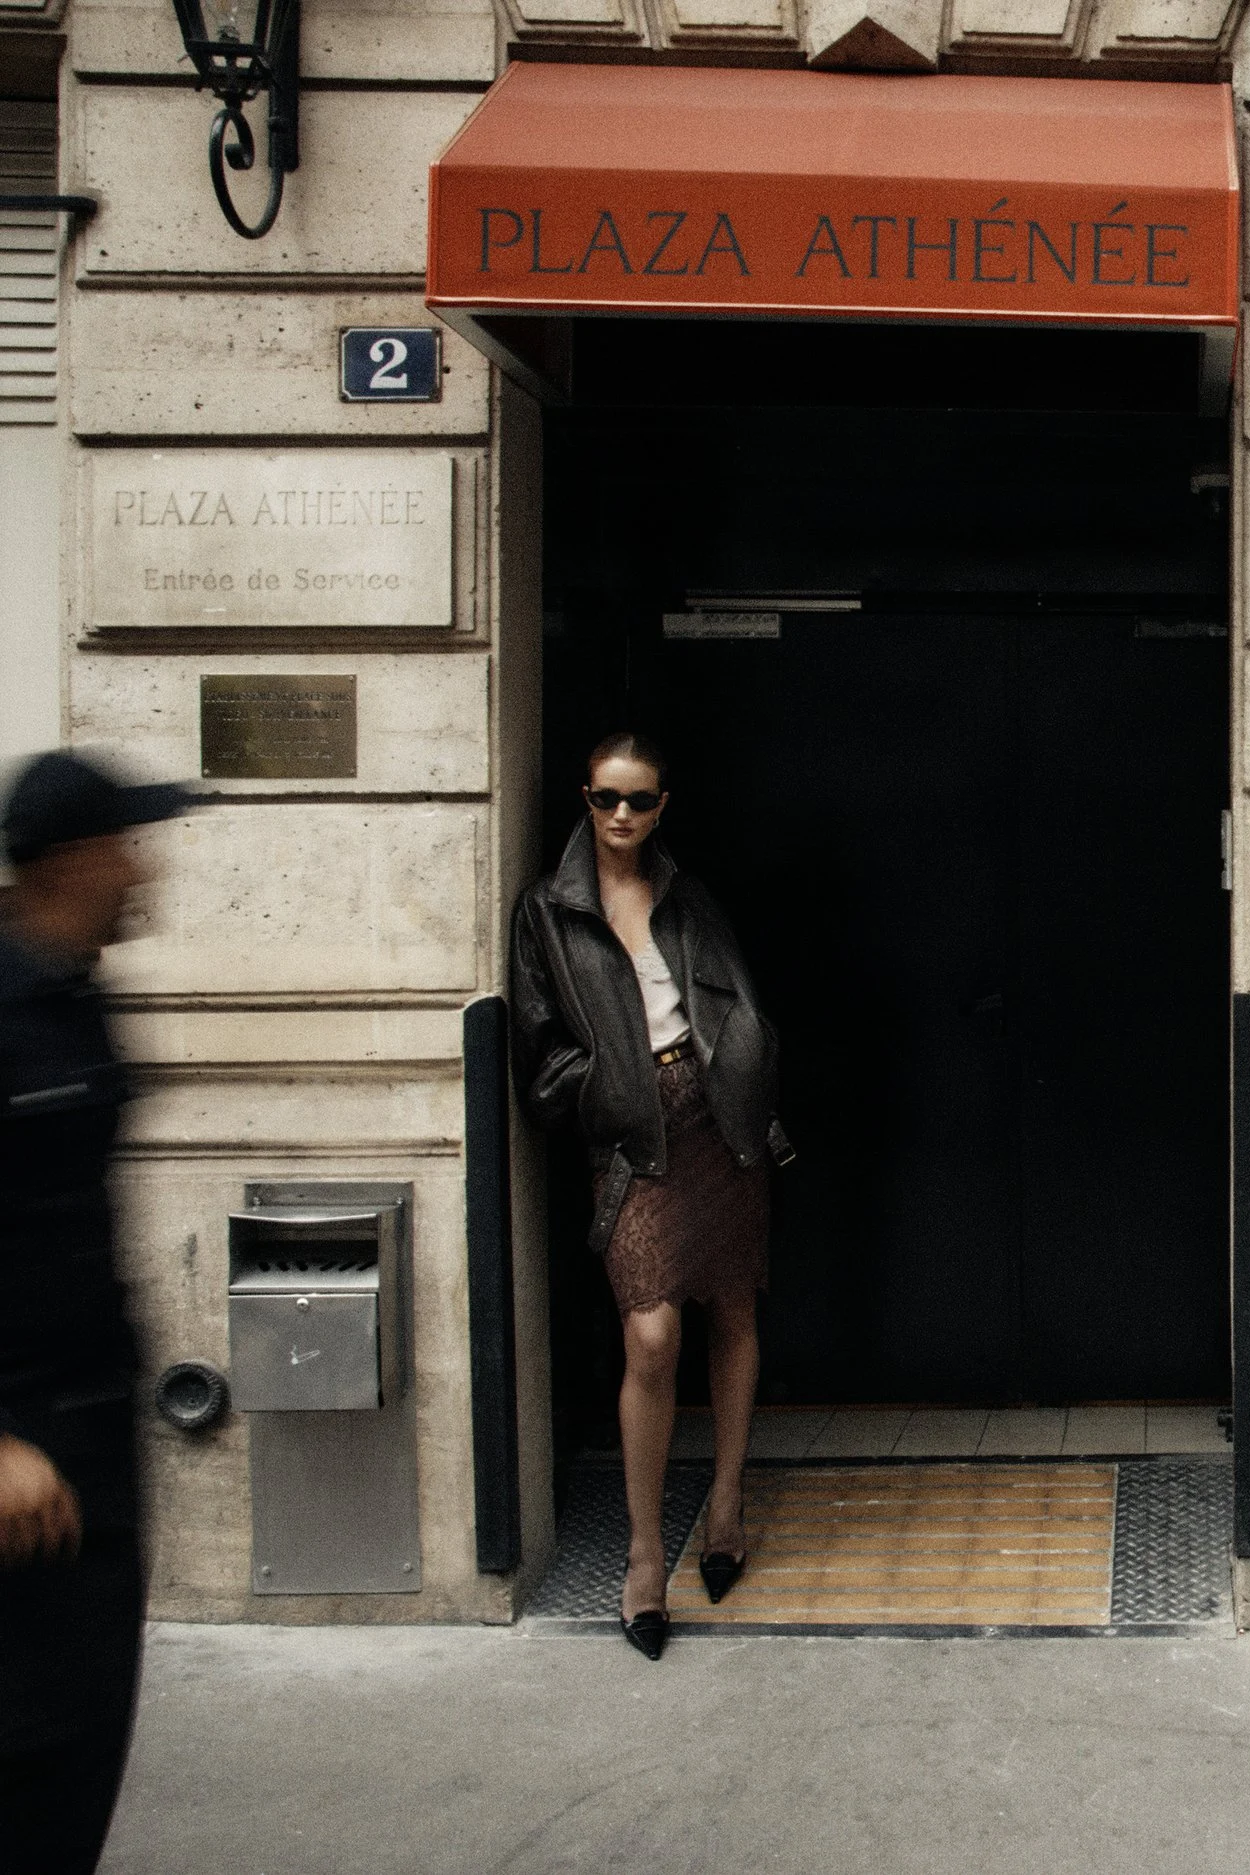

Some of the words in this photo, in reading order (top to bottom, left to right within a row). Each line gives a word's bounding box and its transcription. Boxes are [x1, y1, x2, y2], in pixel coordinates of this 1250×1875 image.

[477, 208, 752, 276] PLAZA
[794, 197, 1192, 288] ATHÉNÉE
[369, 338, 408, 389] 2
[113, 489, 237, 527] PLAZA
[251, 482, 426, 526] ATHÉNÉE
[143, 567, 235, 591] Entrée
[247, 568, 281, 590] de
[293, 567, 401, 590] Service
